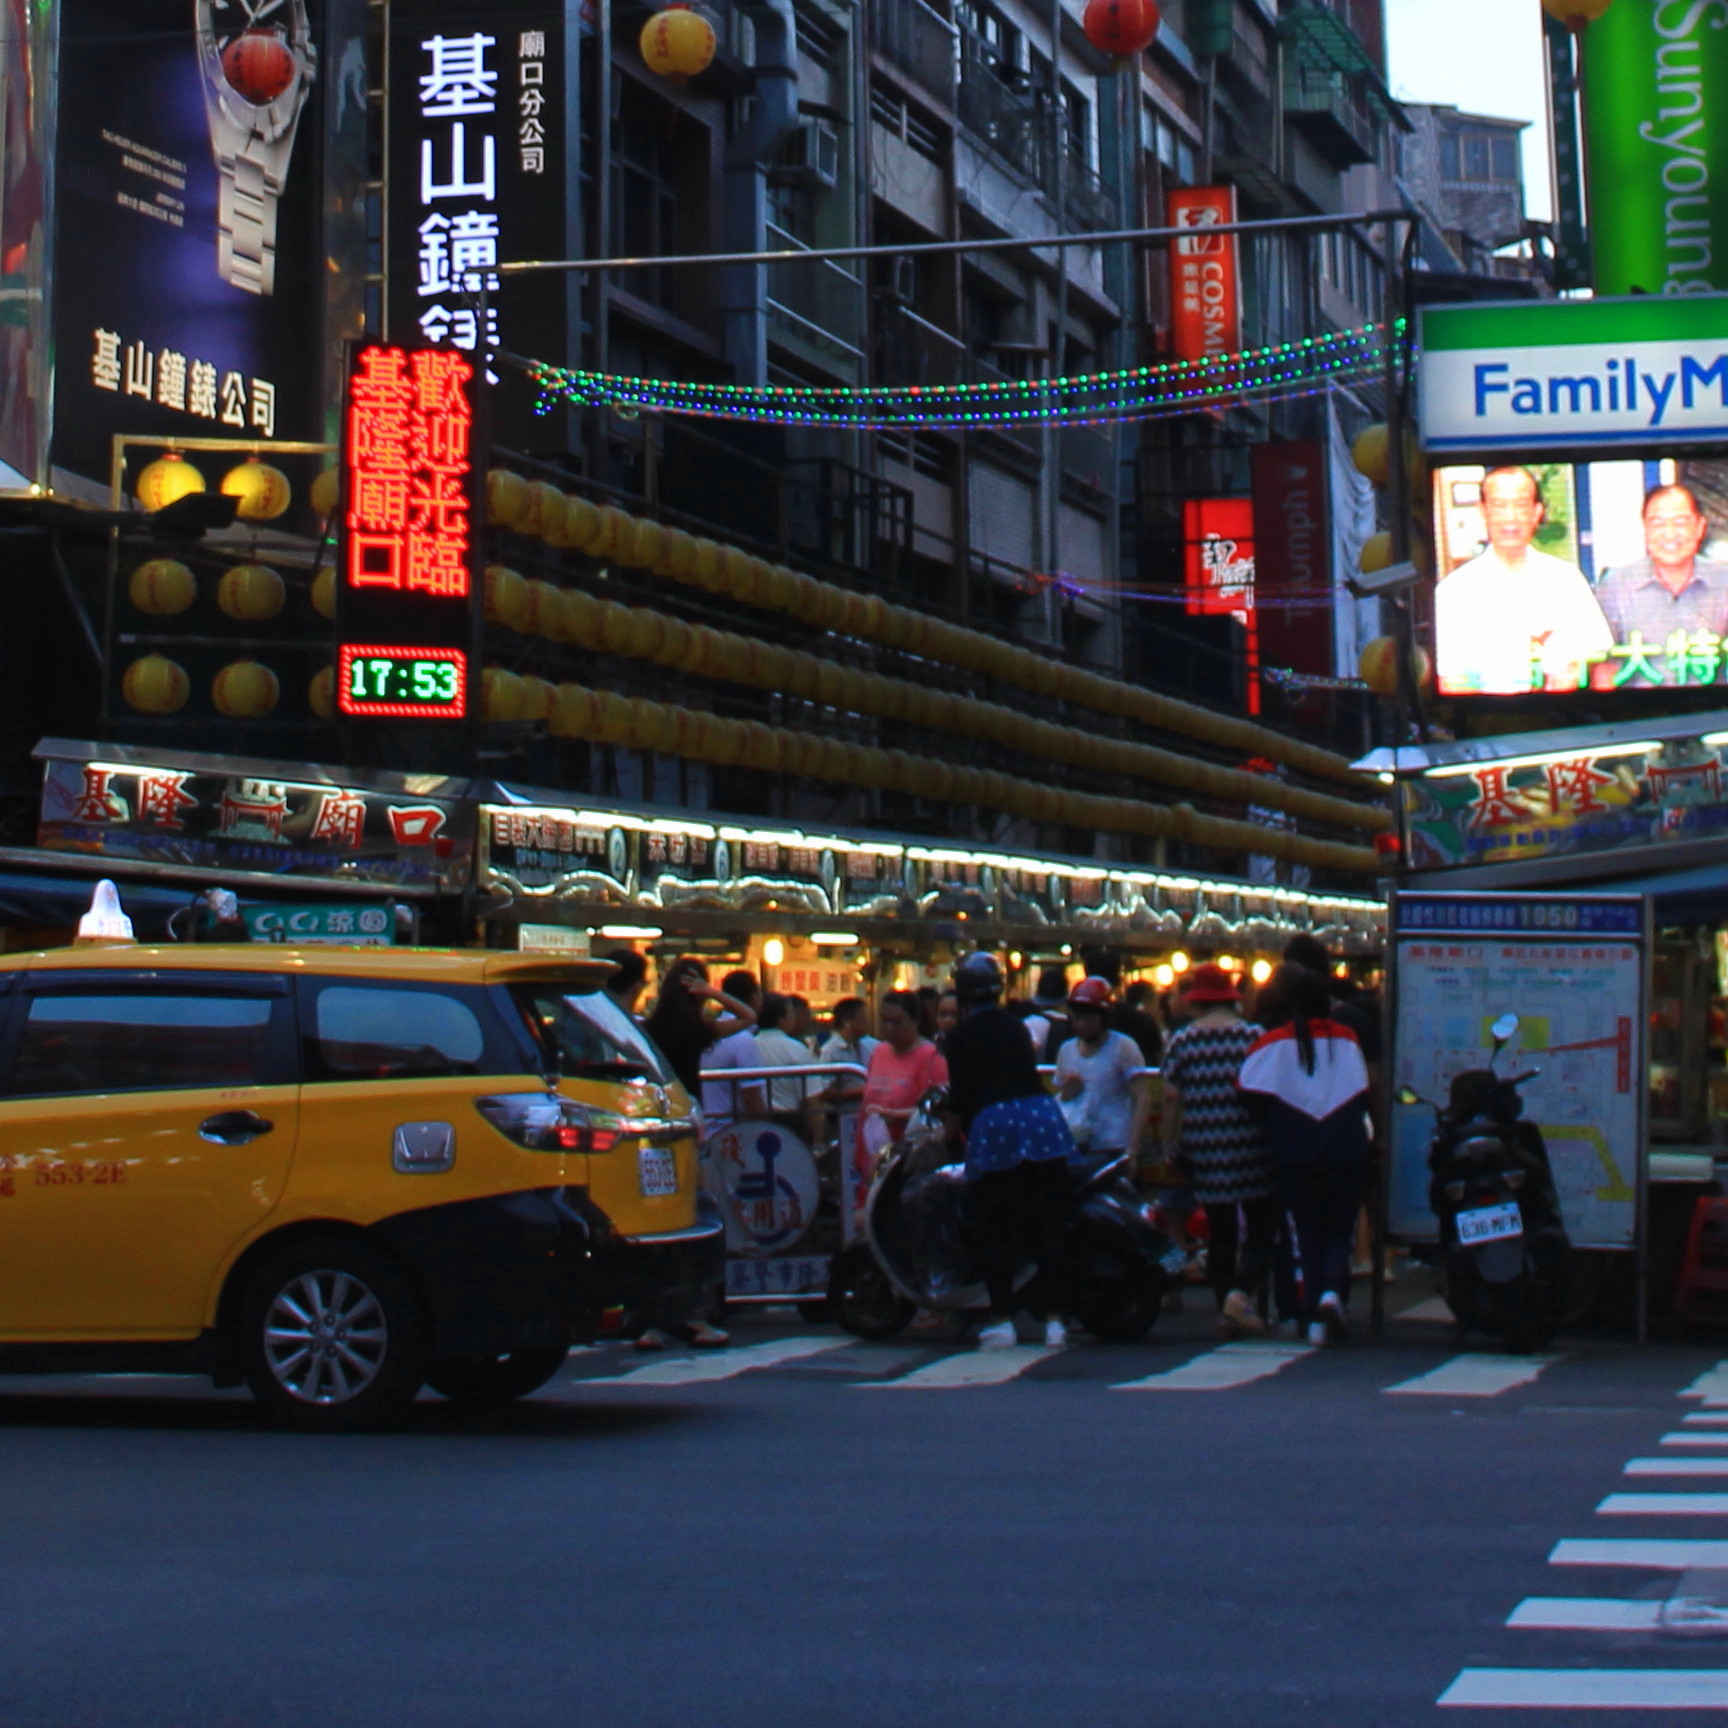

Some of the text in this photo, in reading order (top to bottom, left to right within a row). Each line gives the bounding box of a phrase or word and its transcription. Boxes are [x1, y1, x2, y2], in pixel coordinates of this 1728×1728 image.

[518, 28, 547, 174] 廟口分公司
[1200, 260, 1226, 384] COSM
[346, 347, 410, 589] 基隆廟口
[406, 349, 471, 597] 歡迎光臨
[349, 659, 460, 699] 17:53
[72, 769, 200, 831] 基隆
[309, 787, 448, 850] 廟口
[1472, 754, 1617, 828] 基隆
